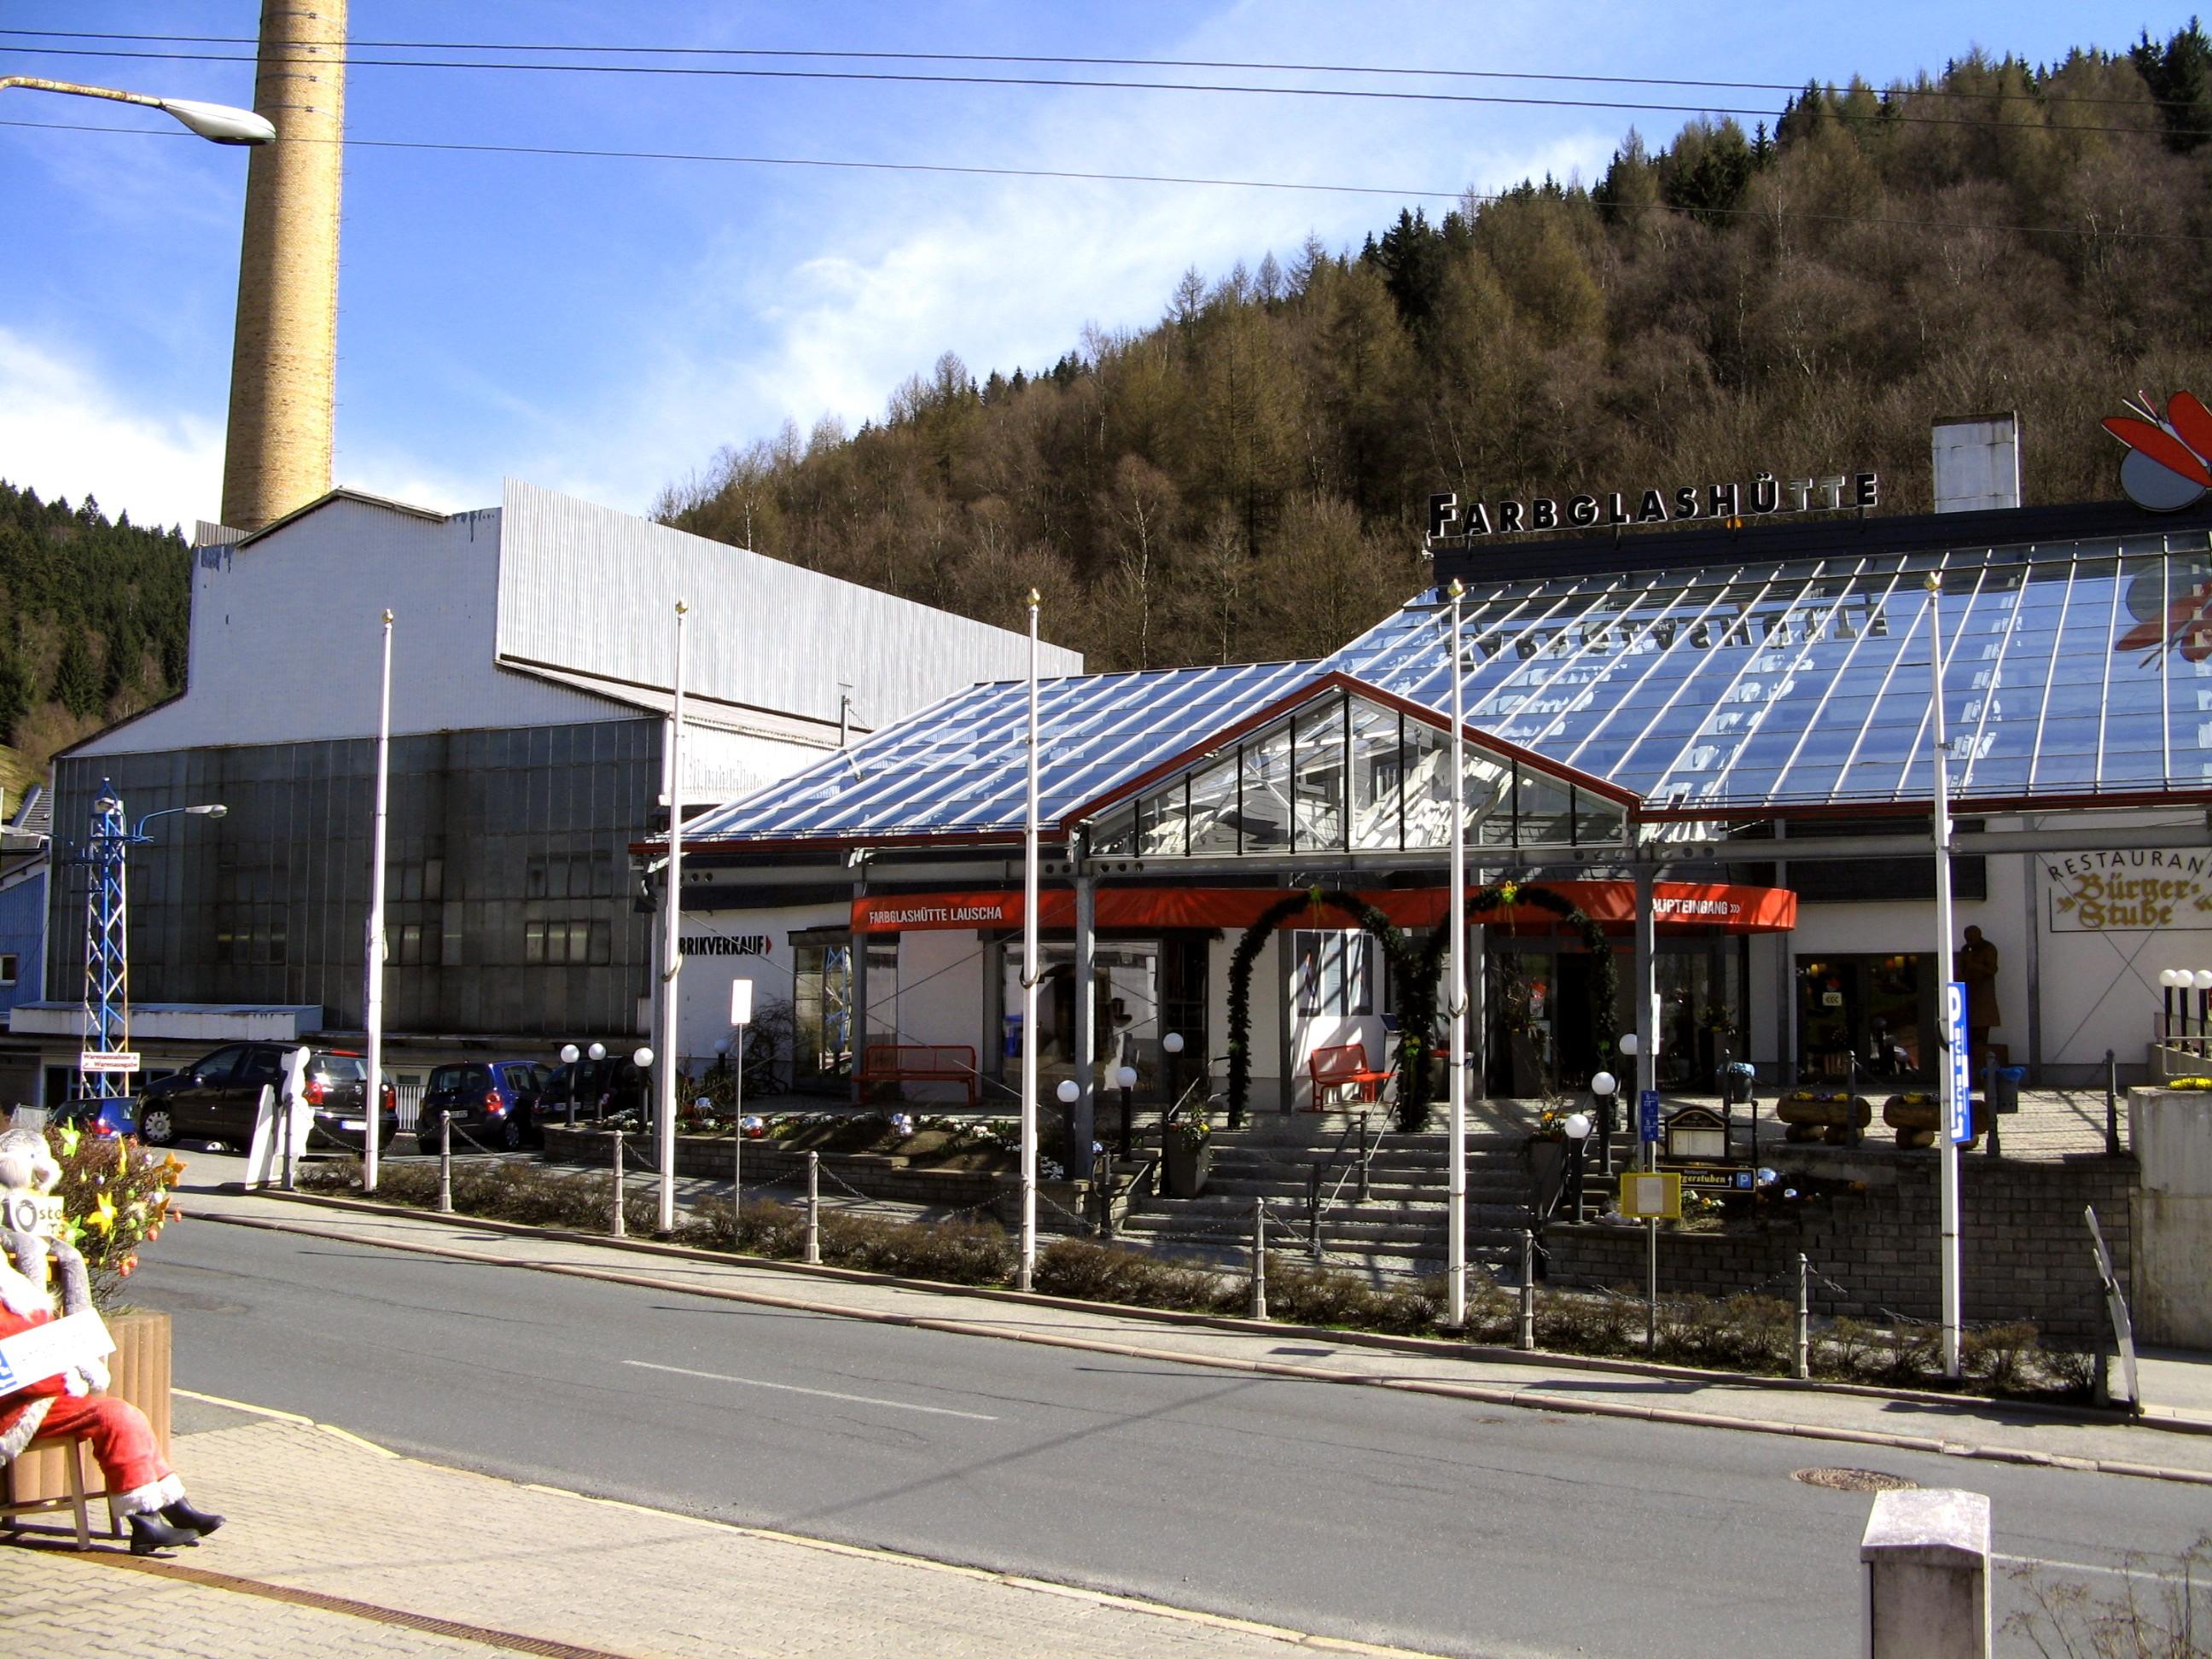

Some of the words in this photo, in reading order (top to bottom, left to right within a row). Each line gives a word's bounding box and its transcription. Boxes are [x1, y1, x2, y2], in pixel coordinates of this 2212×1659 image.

[1427, 472, 1878, 538] FARBGLASHÜTTE
[2073, 872, 2200, 901] Bürger-
[869, 908, 947, 924] FARBGLASHÜTTE
[950, 906, 1002, 922] LAUSCHA
[1652, 898, 1728, 915] AUPTEINGANG
[2079, 899, 2173, 928] Stube
[678, 935, 764, 955] BRIKVERKAUF
[1681, 1174, 1726, 1184] gerstuben
[15, 1199, 62, 1233] Oste
